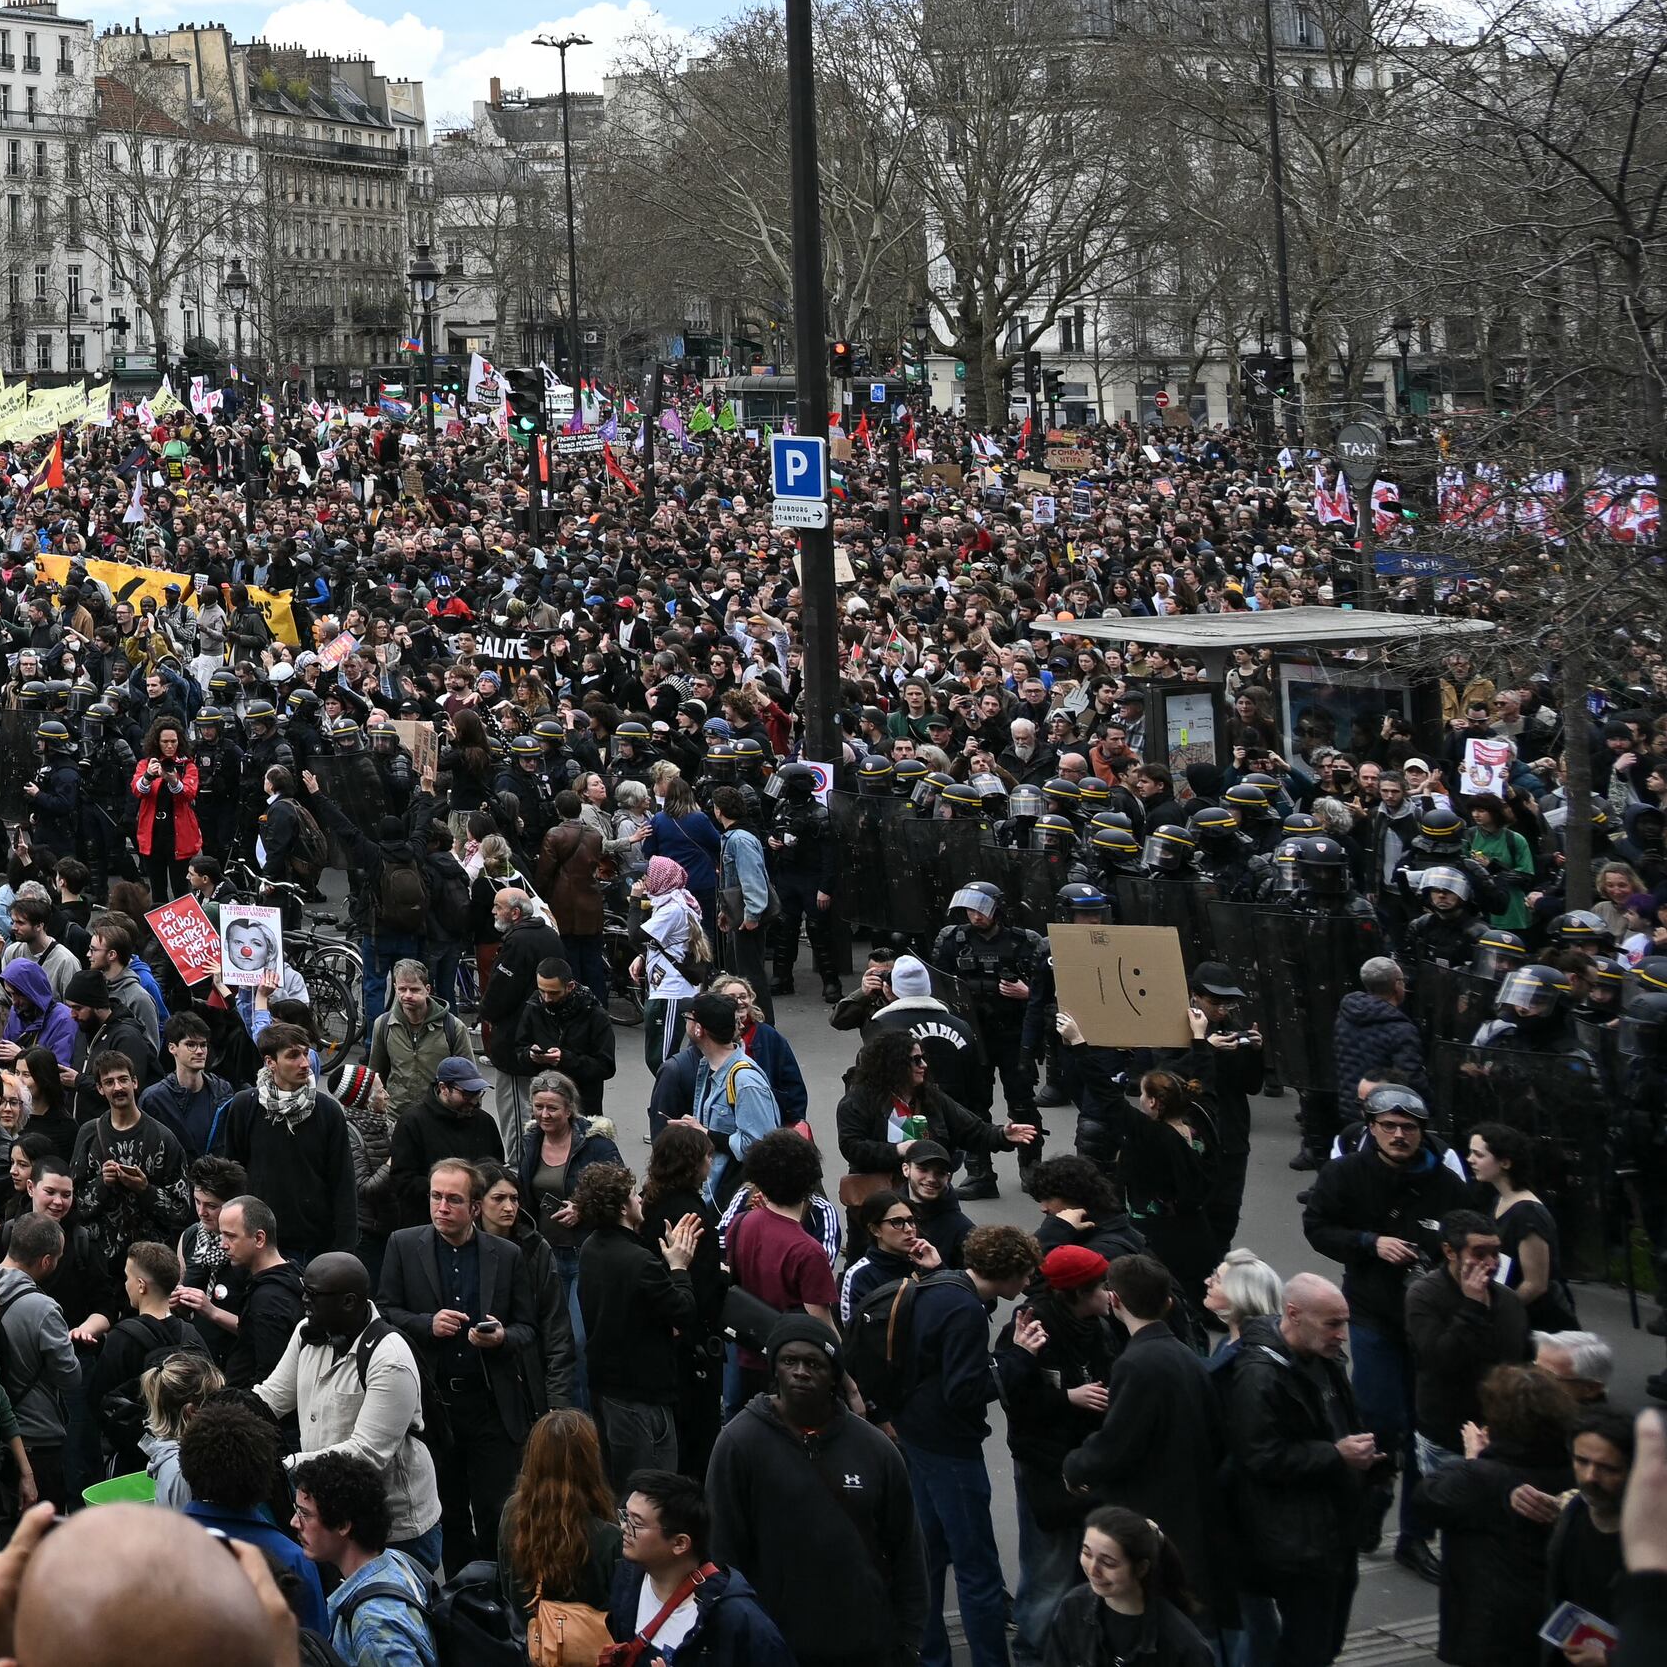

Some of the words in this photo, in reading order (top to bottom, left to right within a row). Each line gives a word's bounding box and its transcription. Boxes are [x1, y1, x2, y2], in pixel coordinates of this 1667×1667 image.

[1340, 442, 1376, 456] TAXI
[786, 449, 808, 487] P
[774, 505, 809, 513] FAUBOURG
[775, 514, 812, 523] ST-ANTOINE
[160, 908, 177, 922] LES
[157, 910, 201, 939] FACHOS,
[166, 922, 211, 951] RENTREZ
[185, 938, 209, 957] CHEZ
